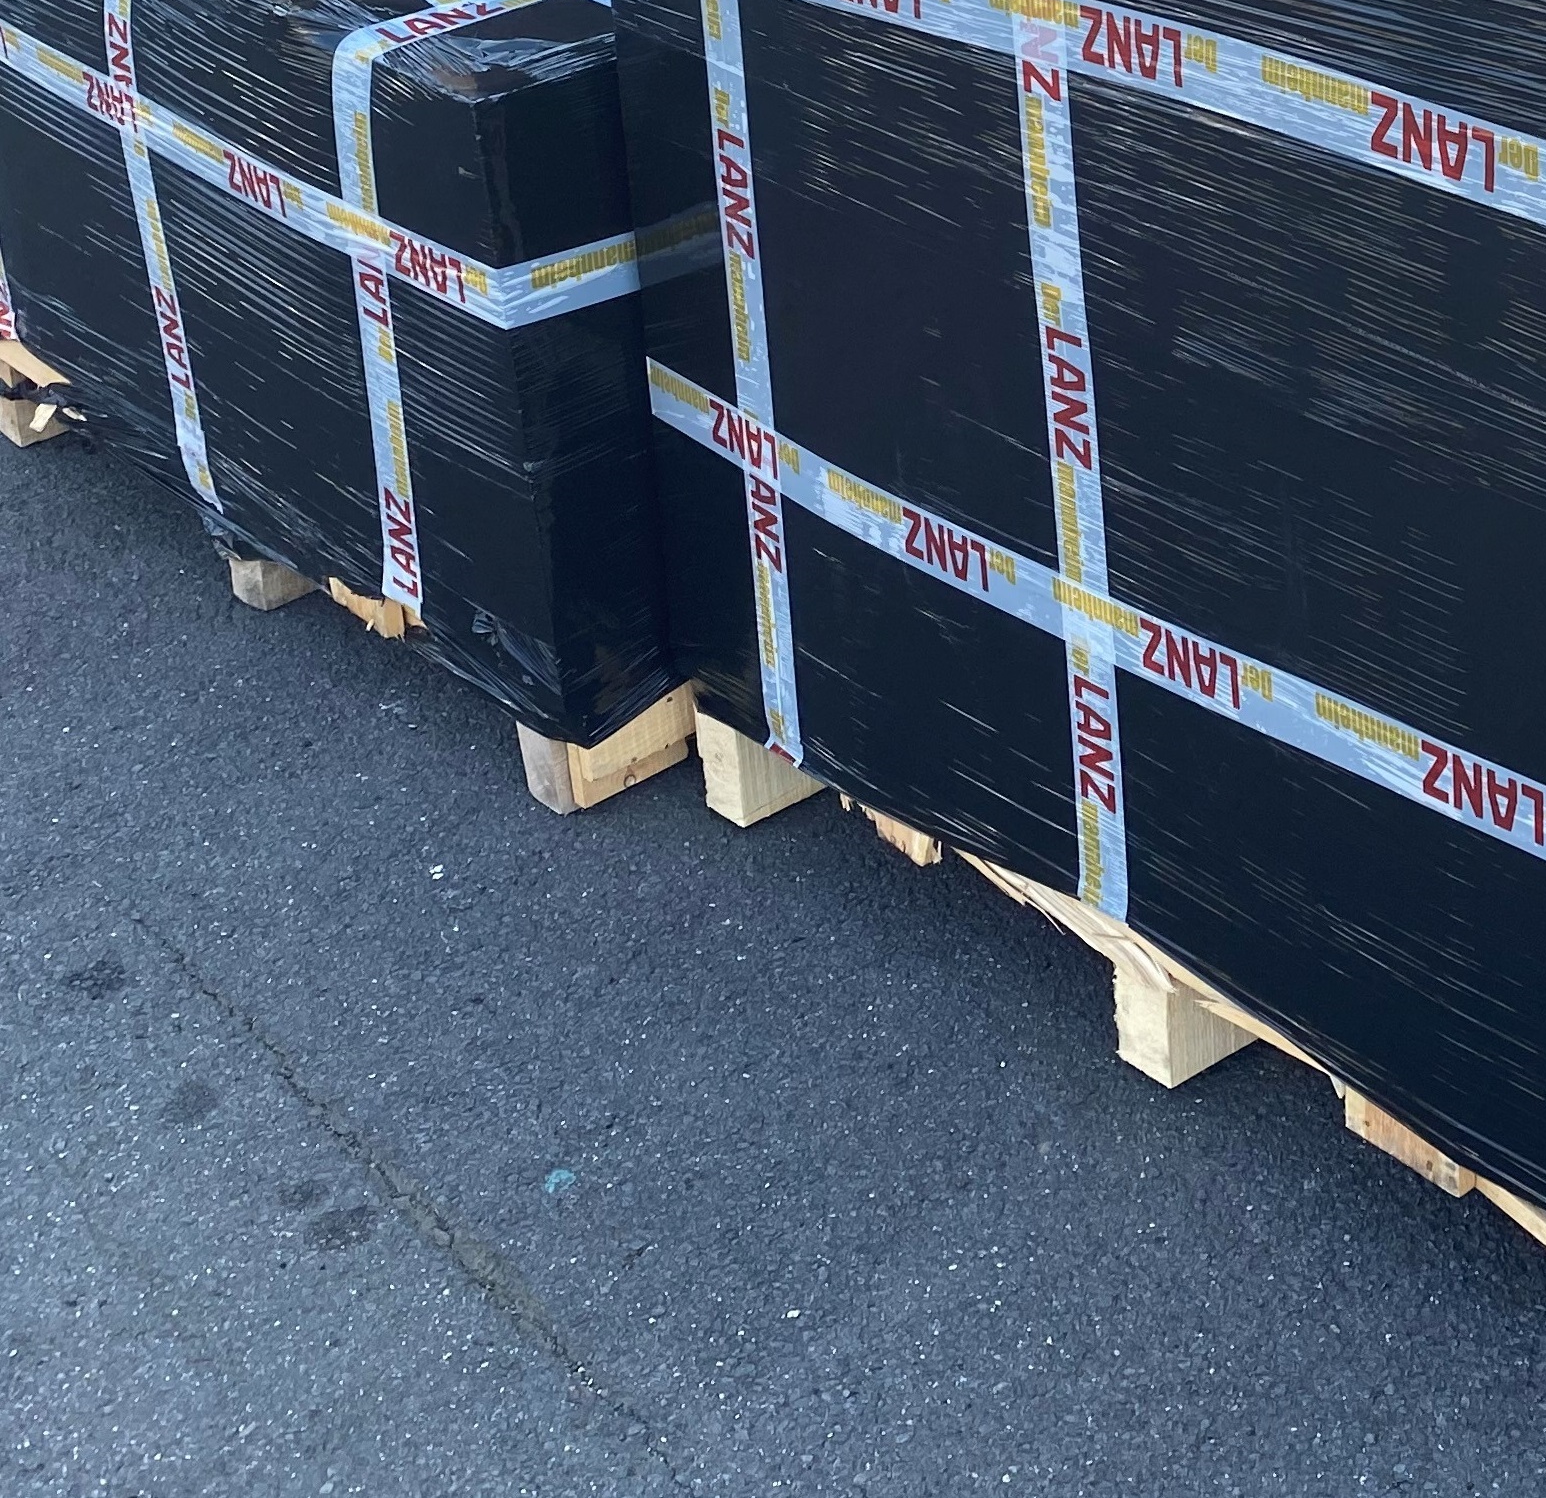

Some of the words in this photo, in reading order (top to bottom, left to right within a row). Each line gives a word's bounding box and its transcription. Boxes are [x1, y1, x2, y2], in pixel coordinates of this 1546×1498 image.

[375, 4, 501, 43] LANZ
[1079, 5, 1183, 87] LANZ
[1185, 37, 1217, 73] Der
[1261, 57, 1370, 115] mannheim
[223, 150, 285, 210] LANZ
[1027, 98, 1050, 225] mannheim
[1370, 91, 1495, 192] LANZ
[1498, 139, 1539, 180] Der
[717, 129, 755, 259] LANZ
[389, 231, 467, 304] LANZ
[1040, 282, 1062, 328] Der
[154, 286, 193, 389] LANZ
[1045, 326, 1092, 470] LANZ
[709, 399, 779, 485] LANZ
[377, 486, 418, 597] LANZ
[902, 507, 989, 591] LANZ
[989, 553, 1015, 581] Der
[1053, 574, 1139, 637] mannheim
[1139, 617, 1241, 709] LANZ
[1241, 666, 1272, 700] Der
[1073, 675, 1116, 813] LANZ
[1315, 695, 1420, 760] mannheim
[1421, 740, 1545, 846] LANZ
